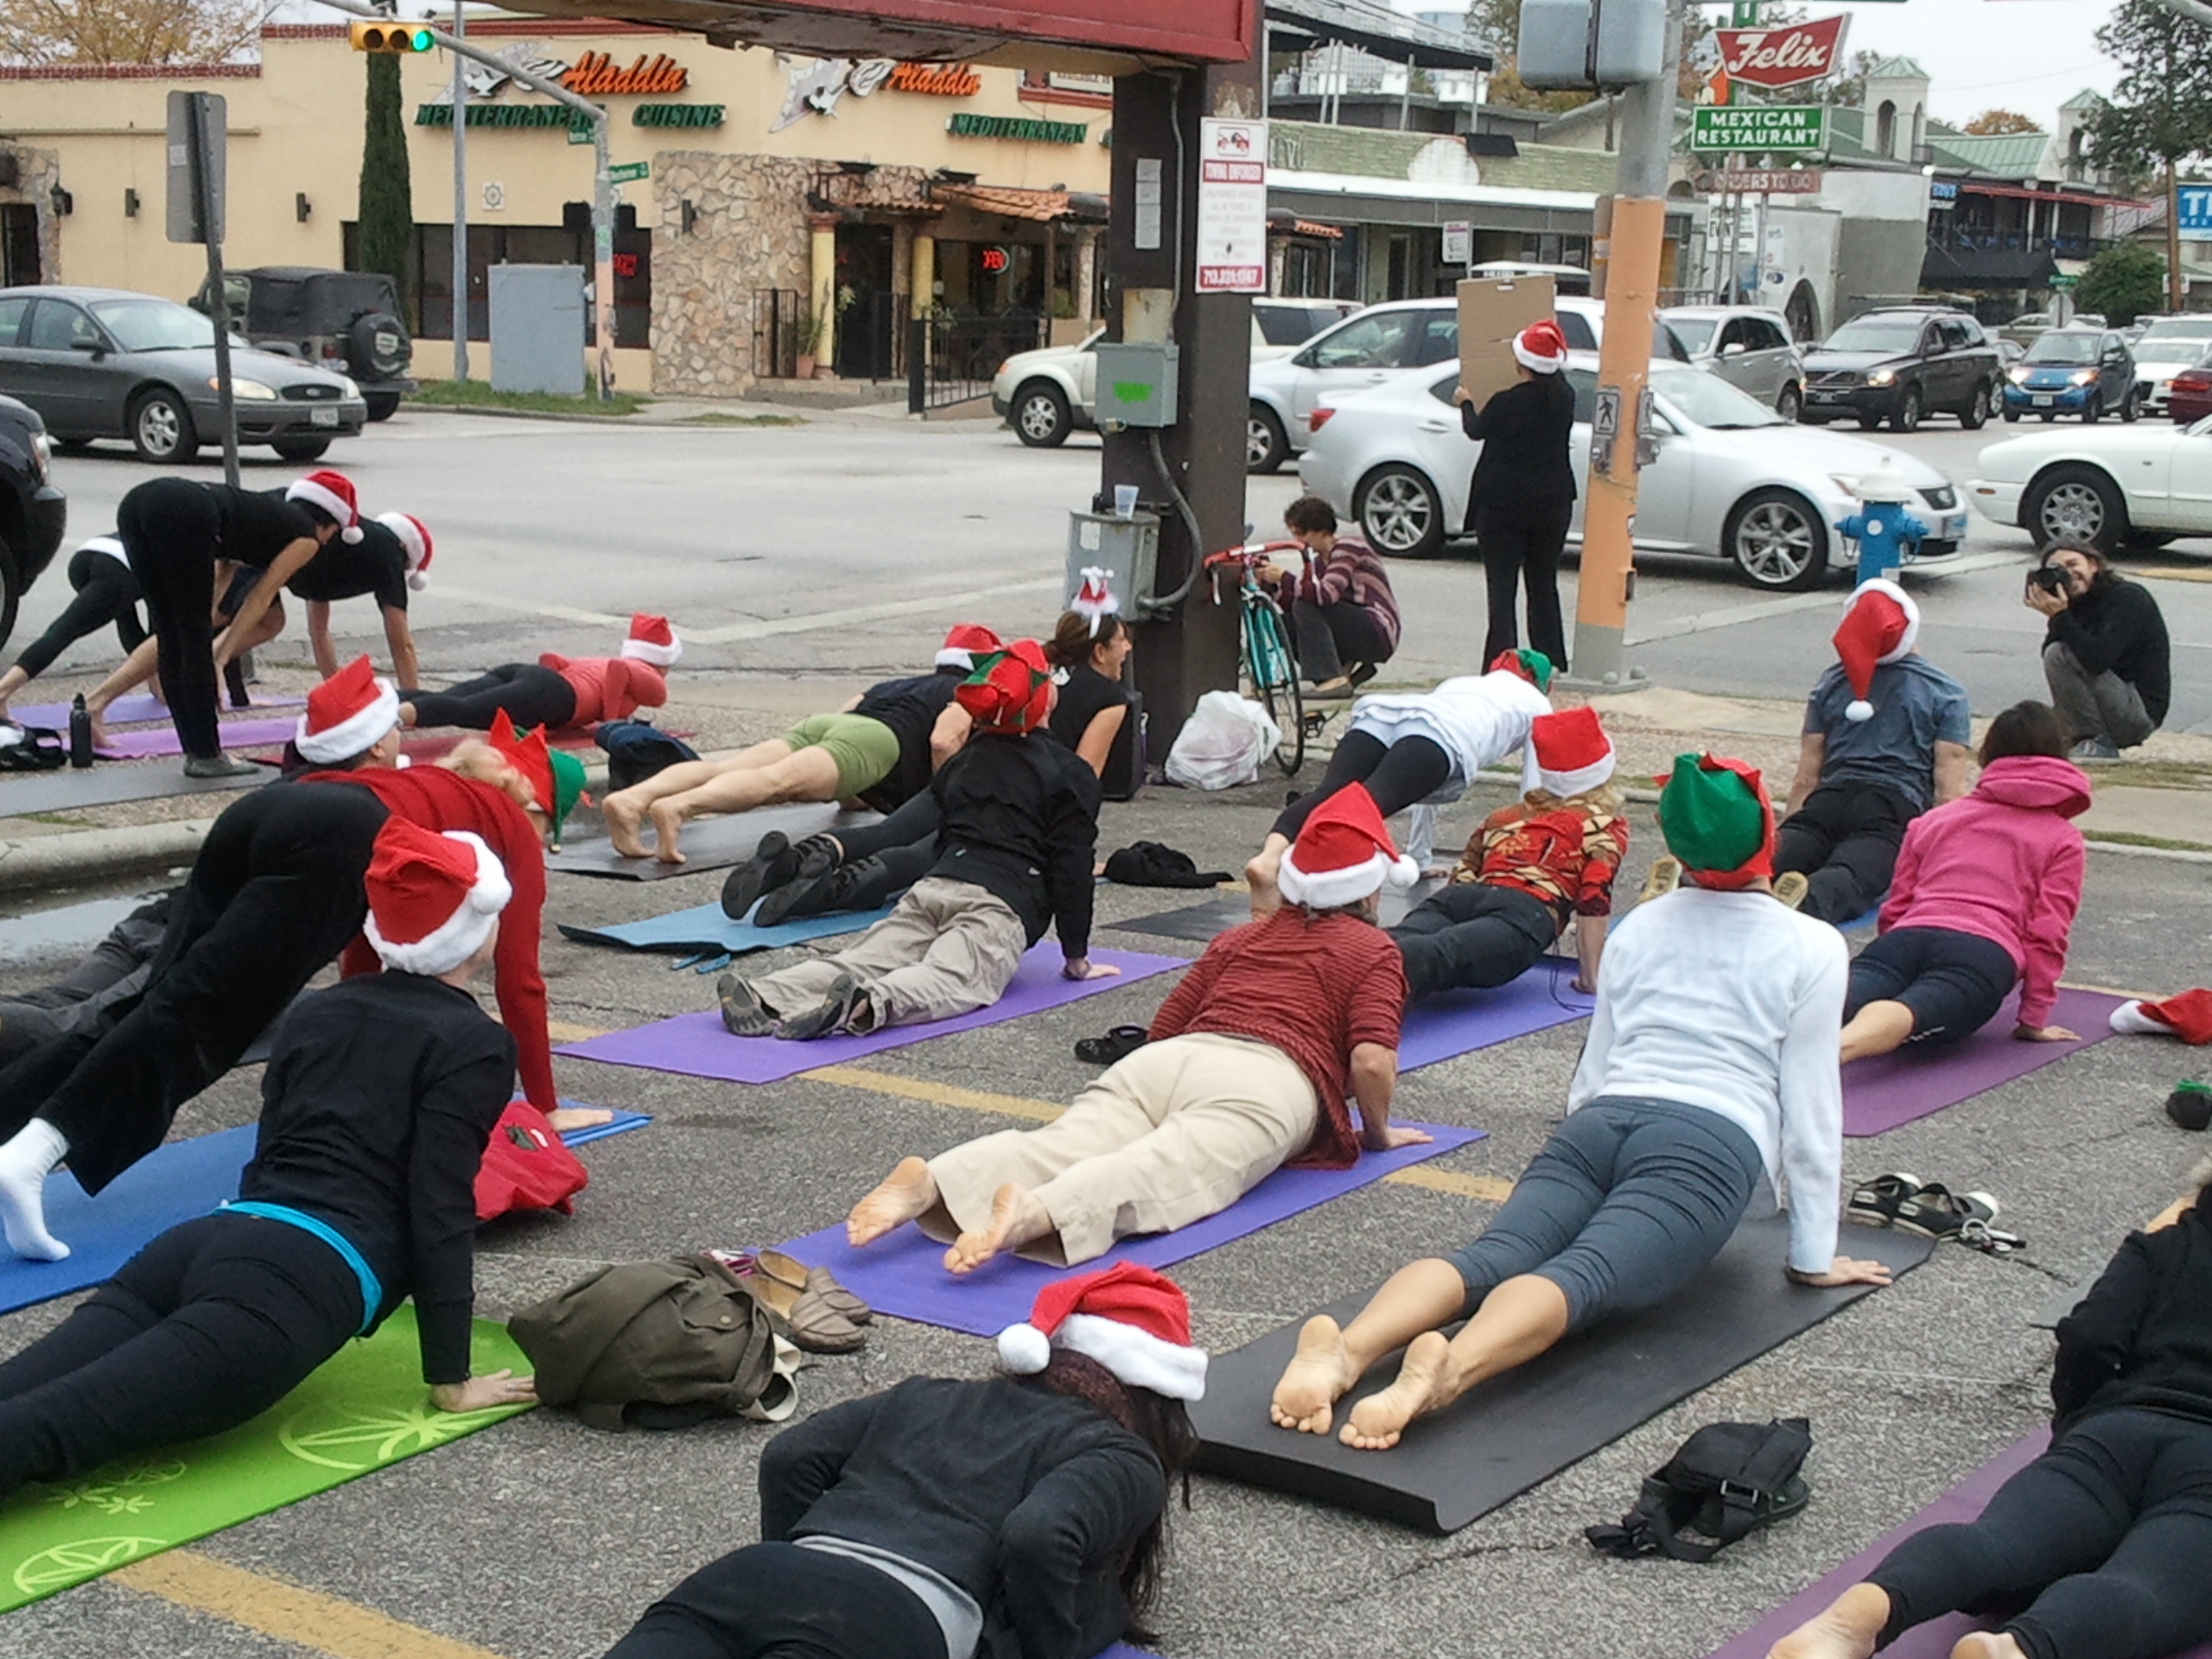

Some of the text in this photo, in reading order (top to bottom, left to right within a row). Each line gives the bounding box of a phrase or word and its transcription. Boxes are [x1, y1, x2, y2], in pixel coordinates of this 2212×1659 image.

[1728, 32, 1828, 73] Felix
[563, 50, 688, 93] Aladdin
[632, 105, 726, 127] CUISINE
[952, 113, 1088, 143] MEDITERRANEAN
[1711, 111, 1806, 127] MEXICAN
[1698, 129, 1819, 144] RESTAURANT
